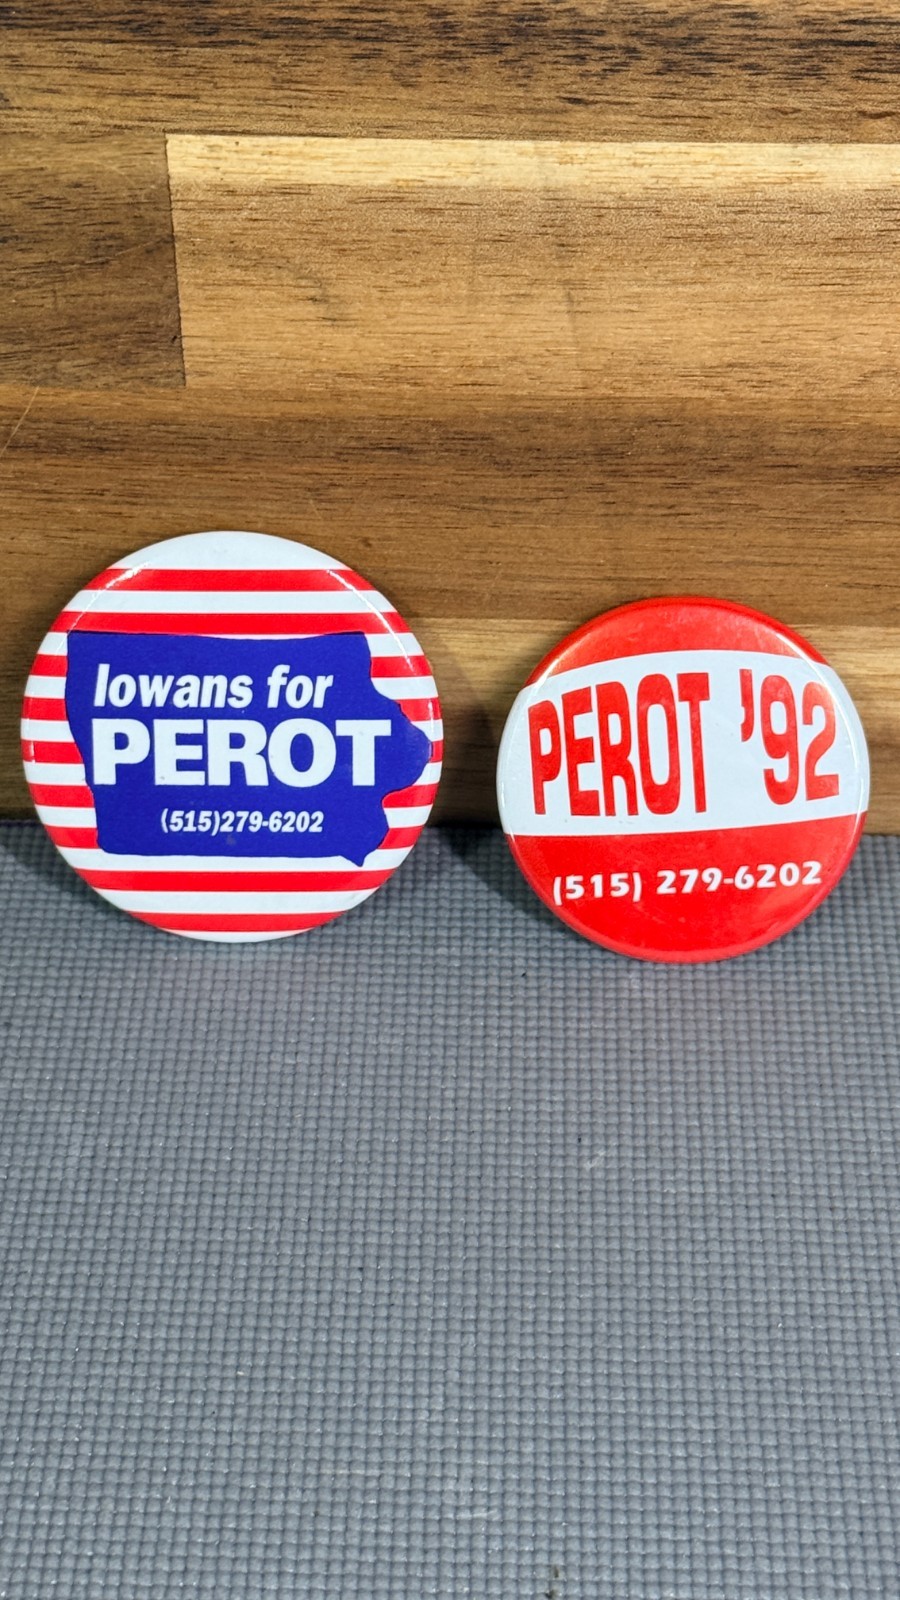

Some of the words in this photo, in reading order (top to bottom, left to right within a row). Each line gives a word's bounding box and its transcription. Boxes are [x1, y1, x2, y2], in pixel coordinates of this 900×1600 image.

[93, 663, 253, 708] Iowans
[267, 664, 334, 709] for
[91, 718, 392, 787] PEROT
[527, 671, 711, 817] PEROT
[739, 668, 840, 805] '92
[161, 808, 324, 836] (515)279-6202
[553, 871, 642, 906] (515)
[656, 861, 822, 894] 279-6202
